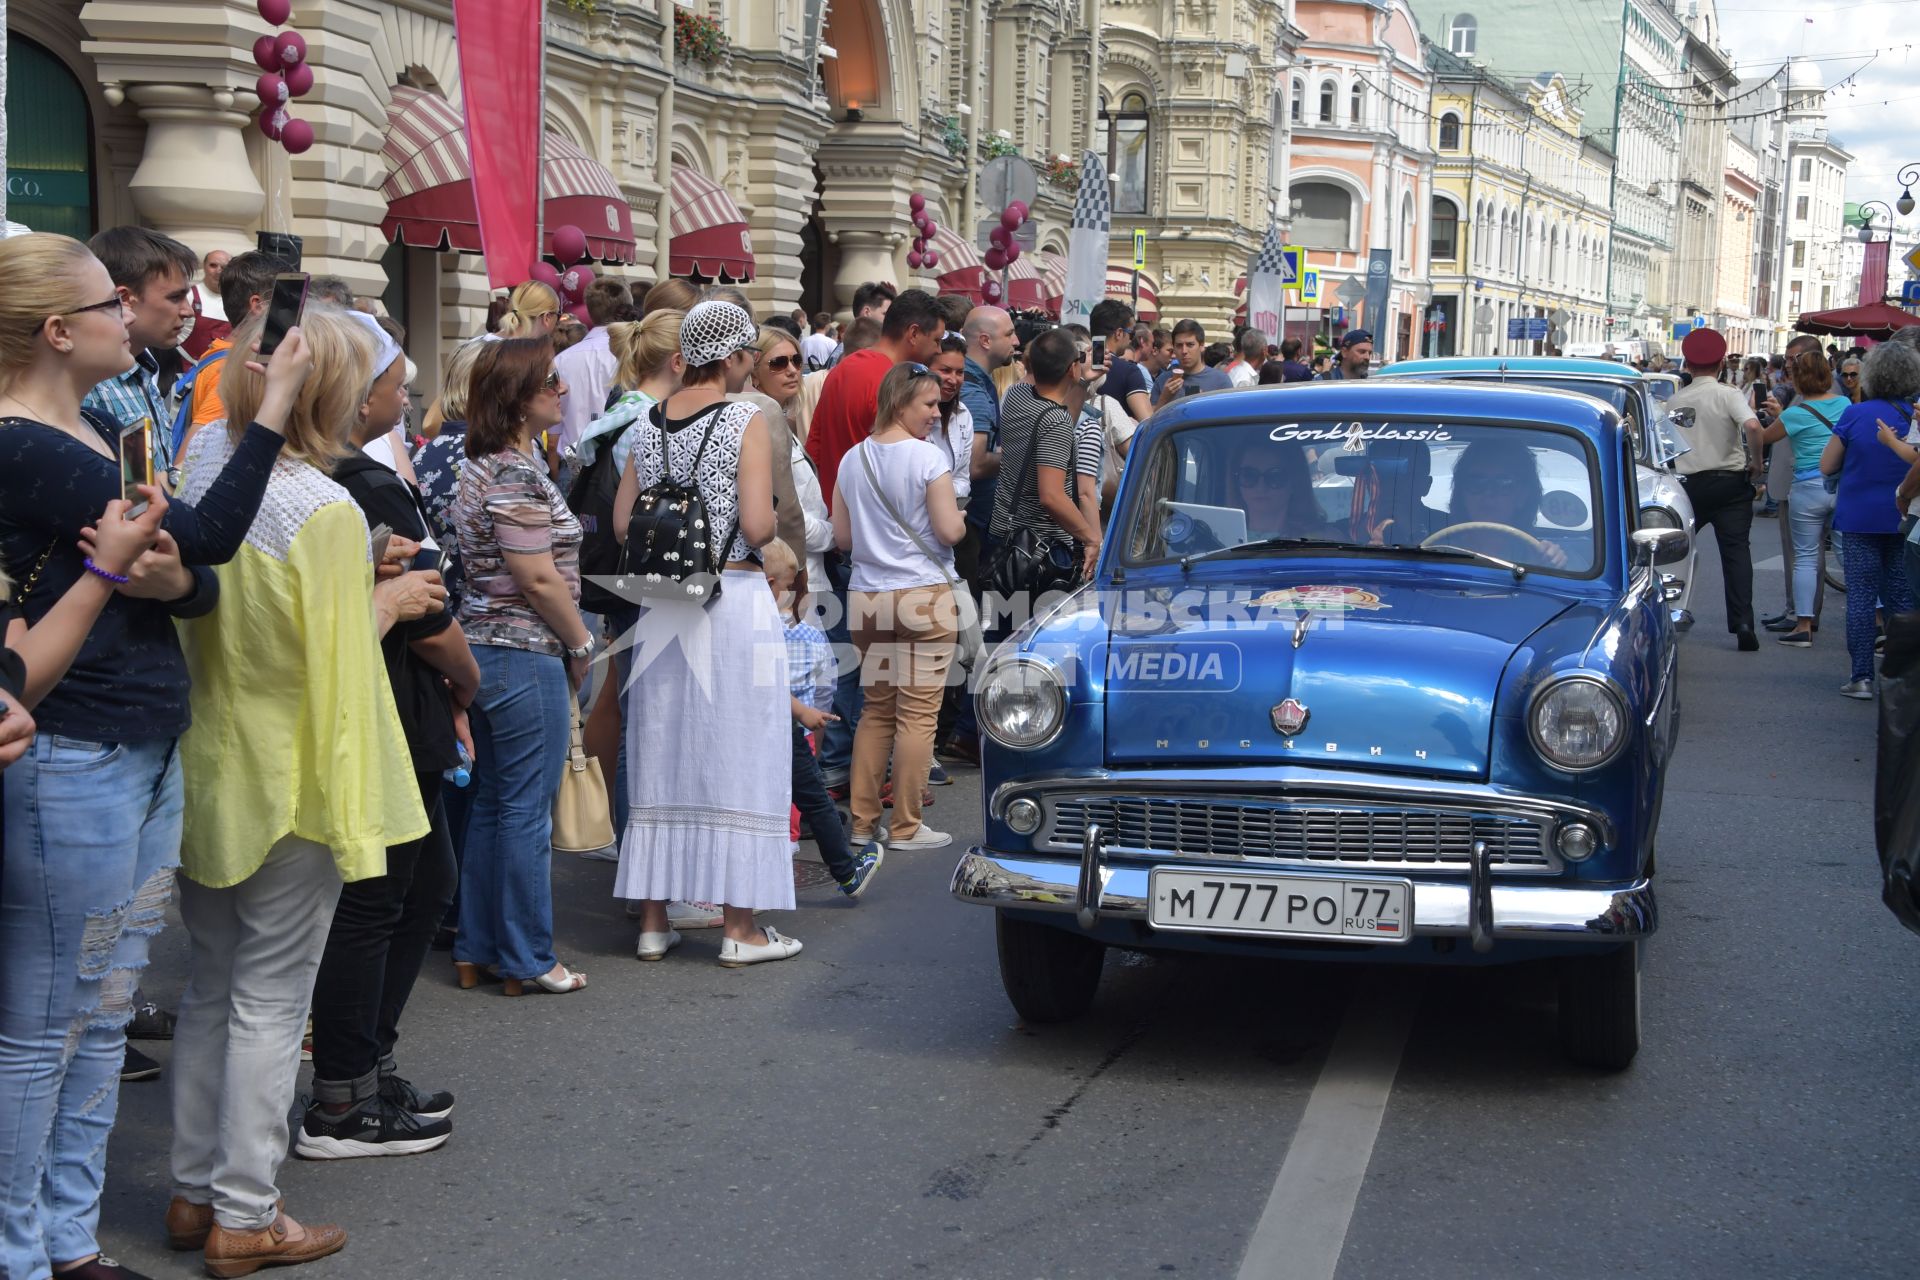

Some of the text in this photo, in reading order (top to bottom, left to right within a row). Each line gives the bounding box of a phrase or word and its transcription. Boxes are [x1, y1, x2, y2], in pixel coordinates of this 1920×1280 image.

[7, 176, 43, 196] Co.
[1157, 739, 1427, 760] МОСКВИЧ
[1351, 887, 1391, 918] 77
[1345, 917, 1375, 930] RUS
[361, 1117, 381, 1127] FILA
